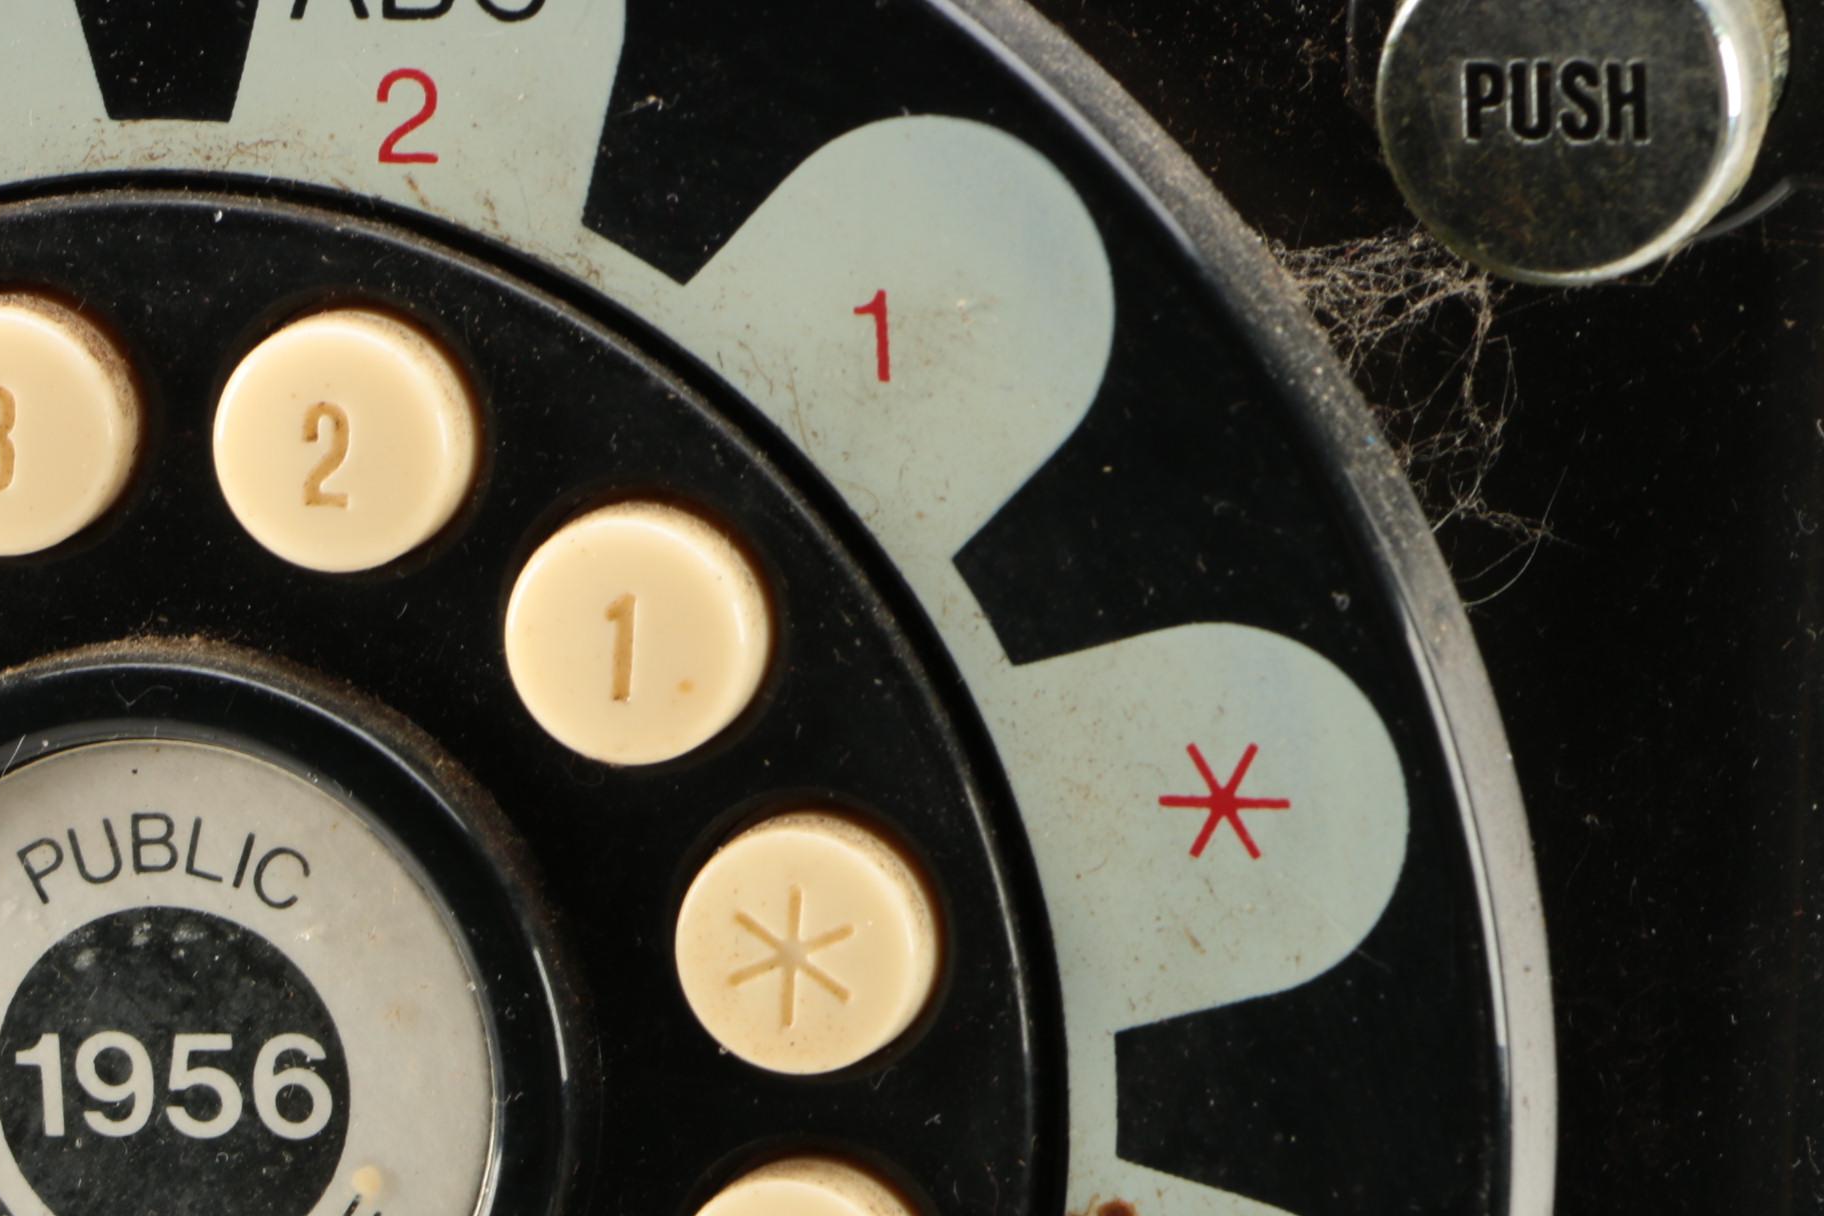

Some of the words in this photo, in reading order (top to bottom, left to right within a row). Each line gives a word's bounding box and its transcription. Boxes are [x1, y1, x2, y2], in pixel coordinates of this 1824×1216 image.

[378, 69, 438, 163] 2
[1462, 59, 1649, 143] PUSH
[855, 291, 889, 381] 1
[302, 402, 348, 508] 2
[605, 595, 635, 703] 1
[18, 813, 311, 910] PUBLIC
[15, 1030, 333, 1141] 1956
